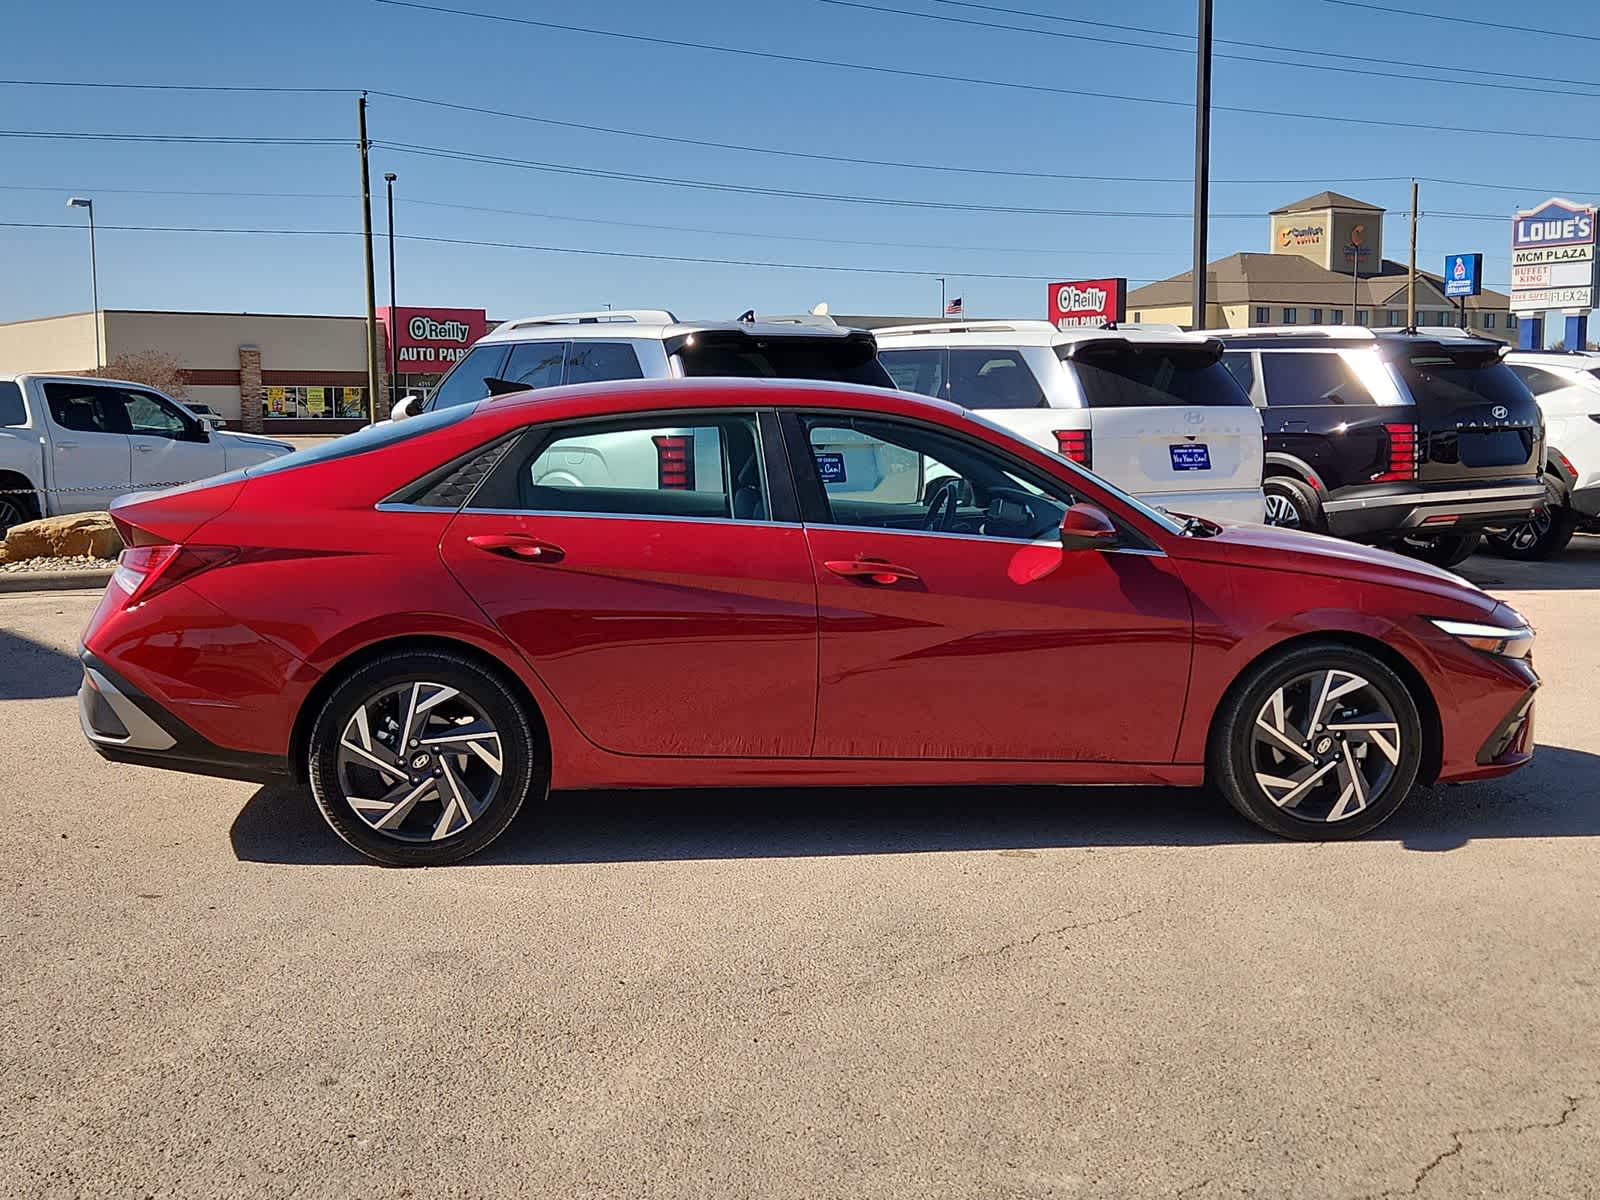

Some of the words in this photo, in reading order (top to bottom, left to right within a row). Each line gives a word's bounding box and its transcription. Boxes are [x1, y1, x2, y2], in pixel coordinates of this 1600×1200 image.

[1518, 216, 1590, 242] LOWE'S
[1516, 252, 1543, 263] MCM
[1546, 248, 1587, 260] PLAZA
[1514, 266, 1548, 276] BUFFET
[1519, 274, 1543, 283] KING
[1057, 285, 1107, 313] O'Reilly
[1058, 316, 1079, 328] AUTO
[1080, 315, 1107, 328] PARTS
[409, 316, 470, 342] O'Reilly
[399, 347, 435, 361] AUTO
